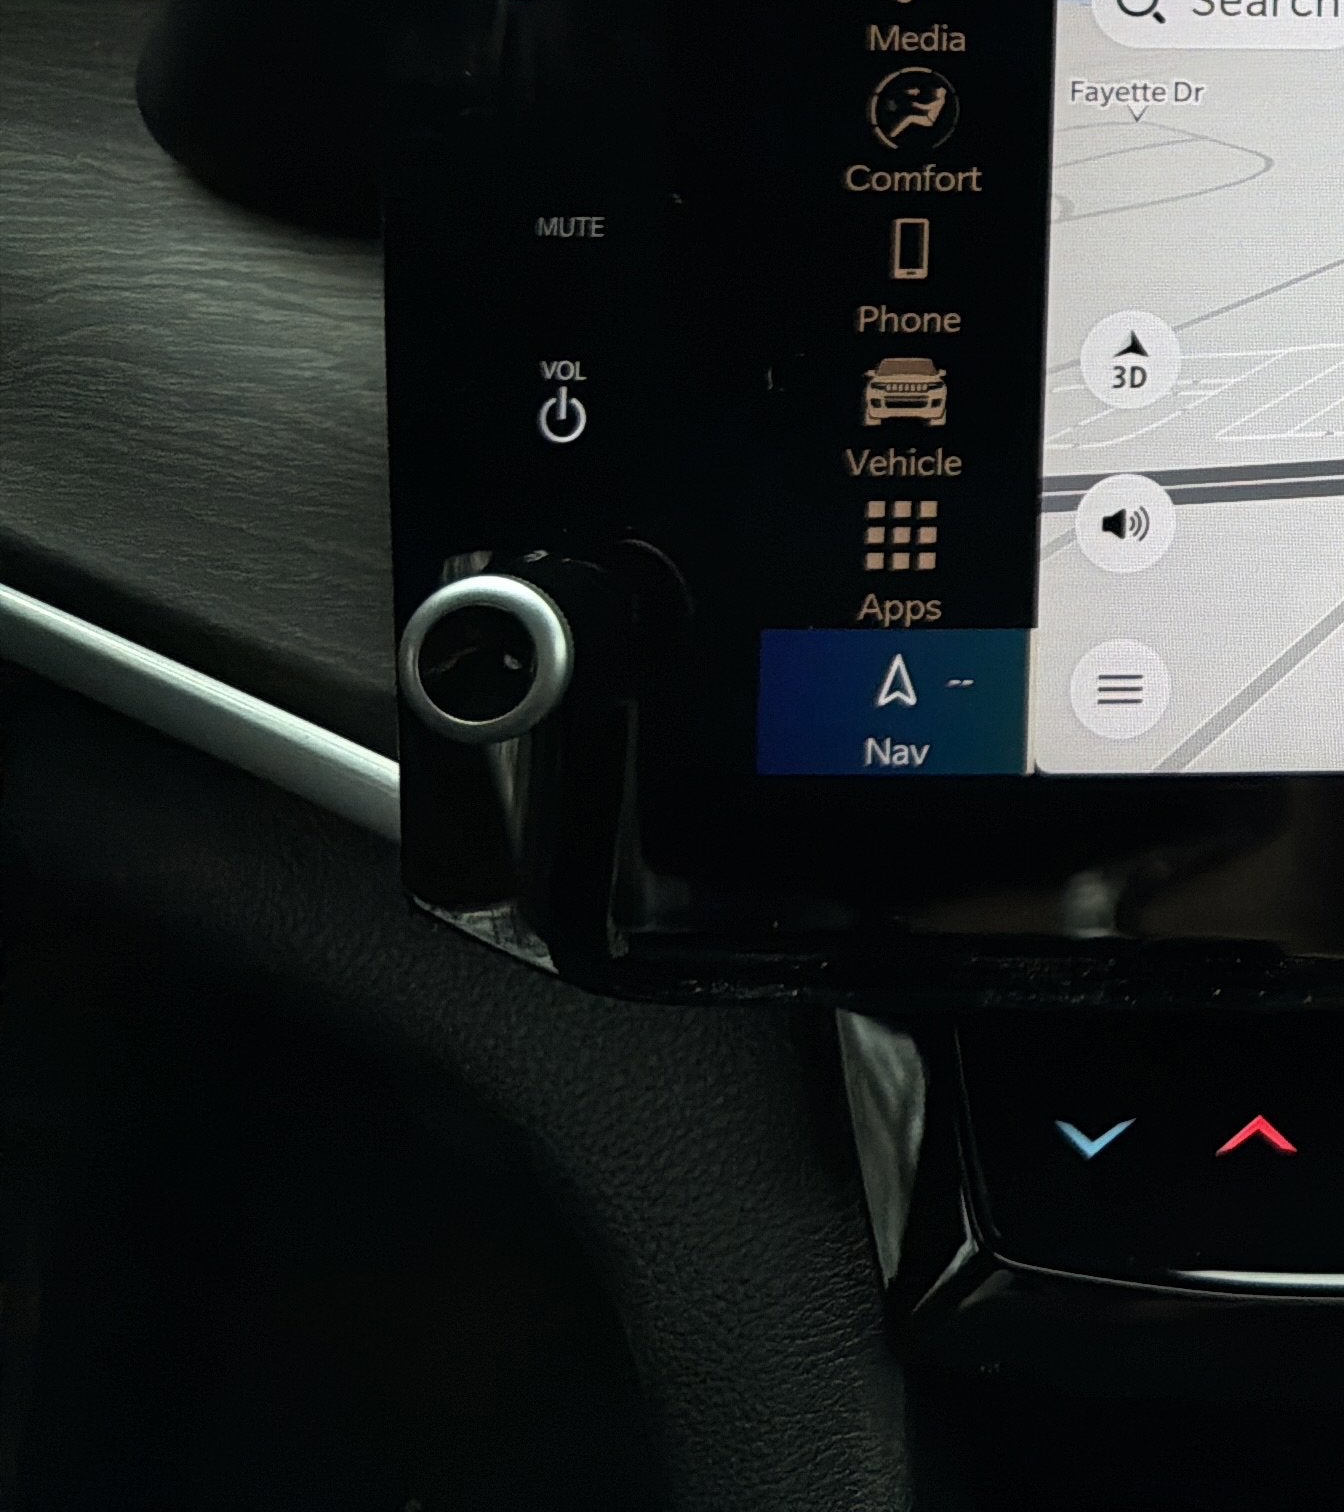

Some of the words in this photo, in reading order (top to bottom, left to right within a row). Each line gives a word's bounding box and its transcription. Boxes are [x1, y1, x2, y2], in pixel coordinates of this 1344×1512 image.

[868, 23, 966, 52] Media
[1070, 80, 1166, 108] Fayette
[1173, 81, 1204, 103] Dr
[844, 163, 983, 192] Comfort
[536, 216, 605, 238] MUTE
[857, 304, 962, 333] Phone
[540, 360, 587, 381] VOL
[1111, 365, 1147, 389] 3D
[845, 447, 962, 477] Vehicle
[856, 593, 942, 628] Apps
[864, 737, 930, 766] Nav
